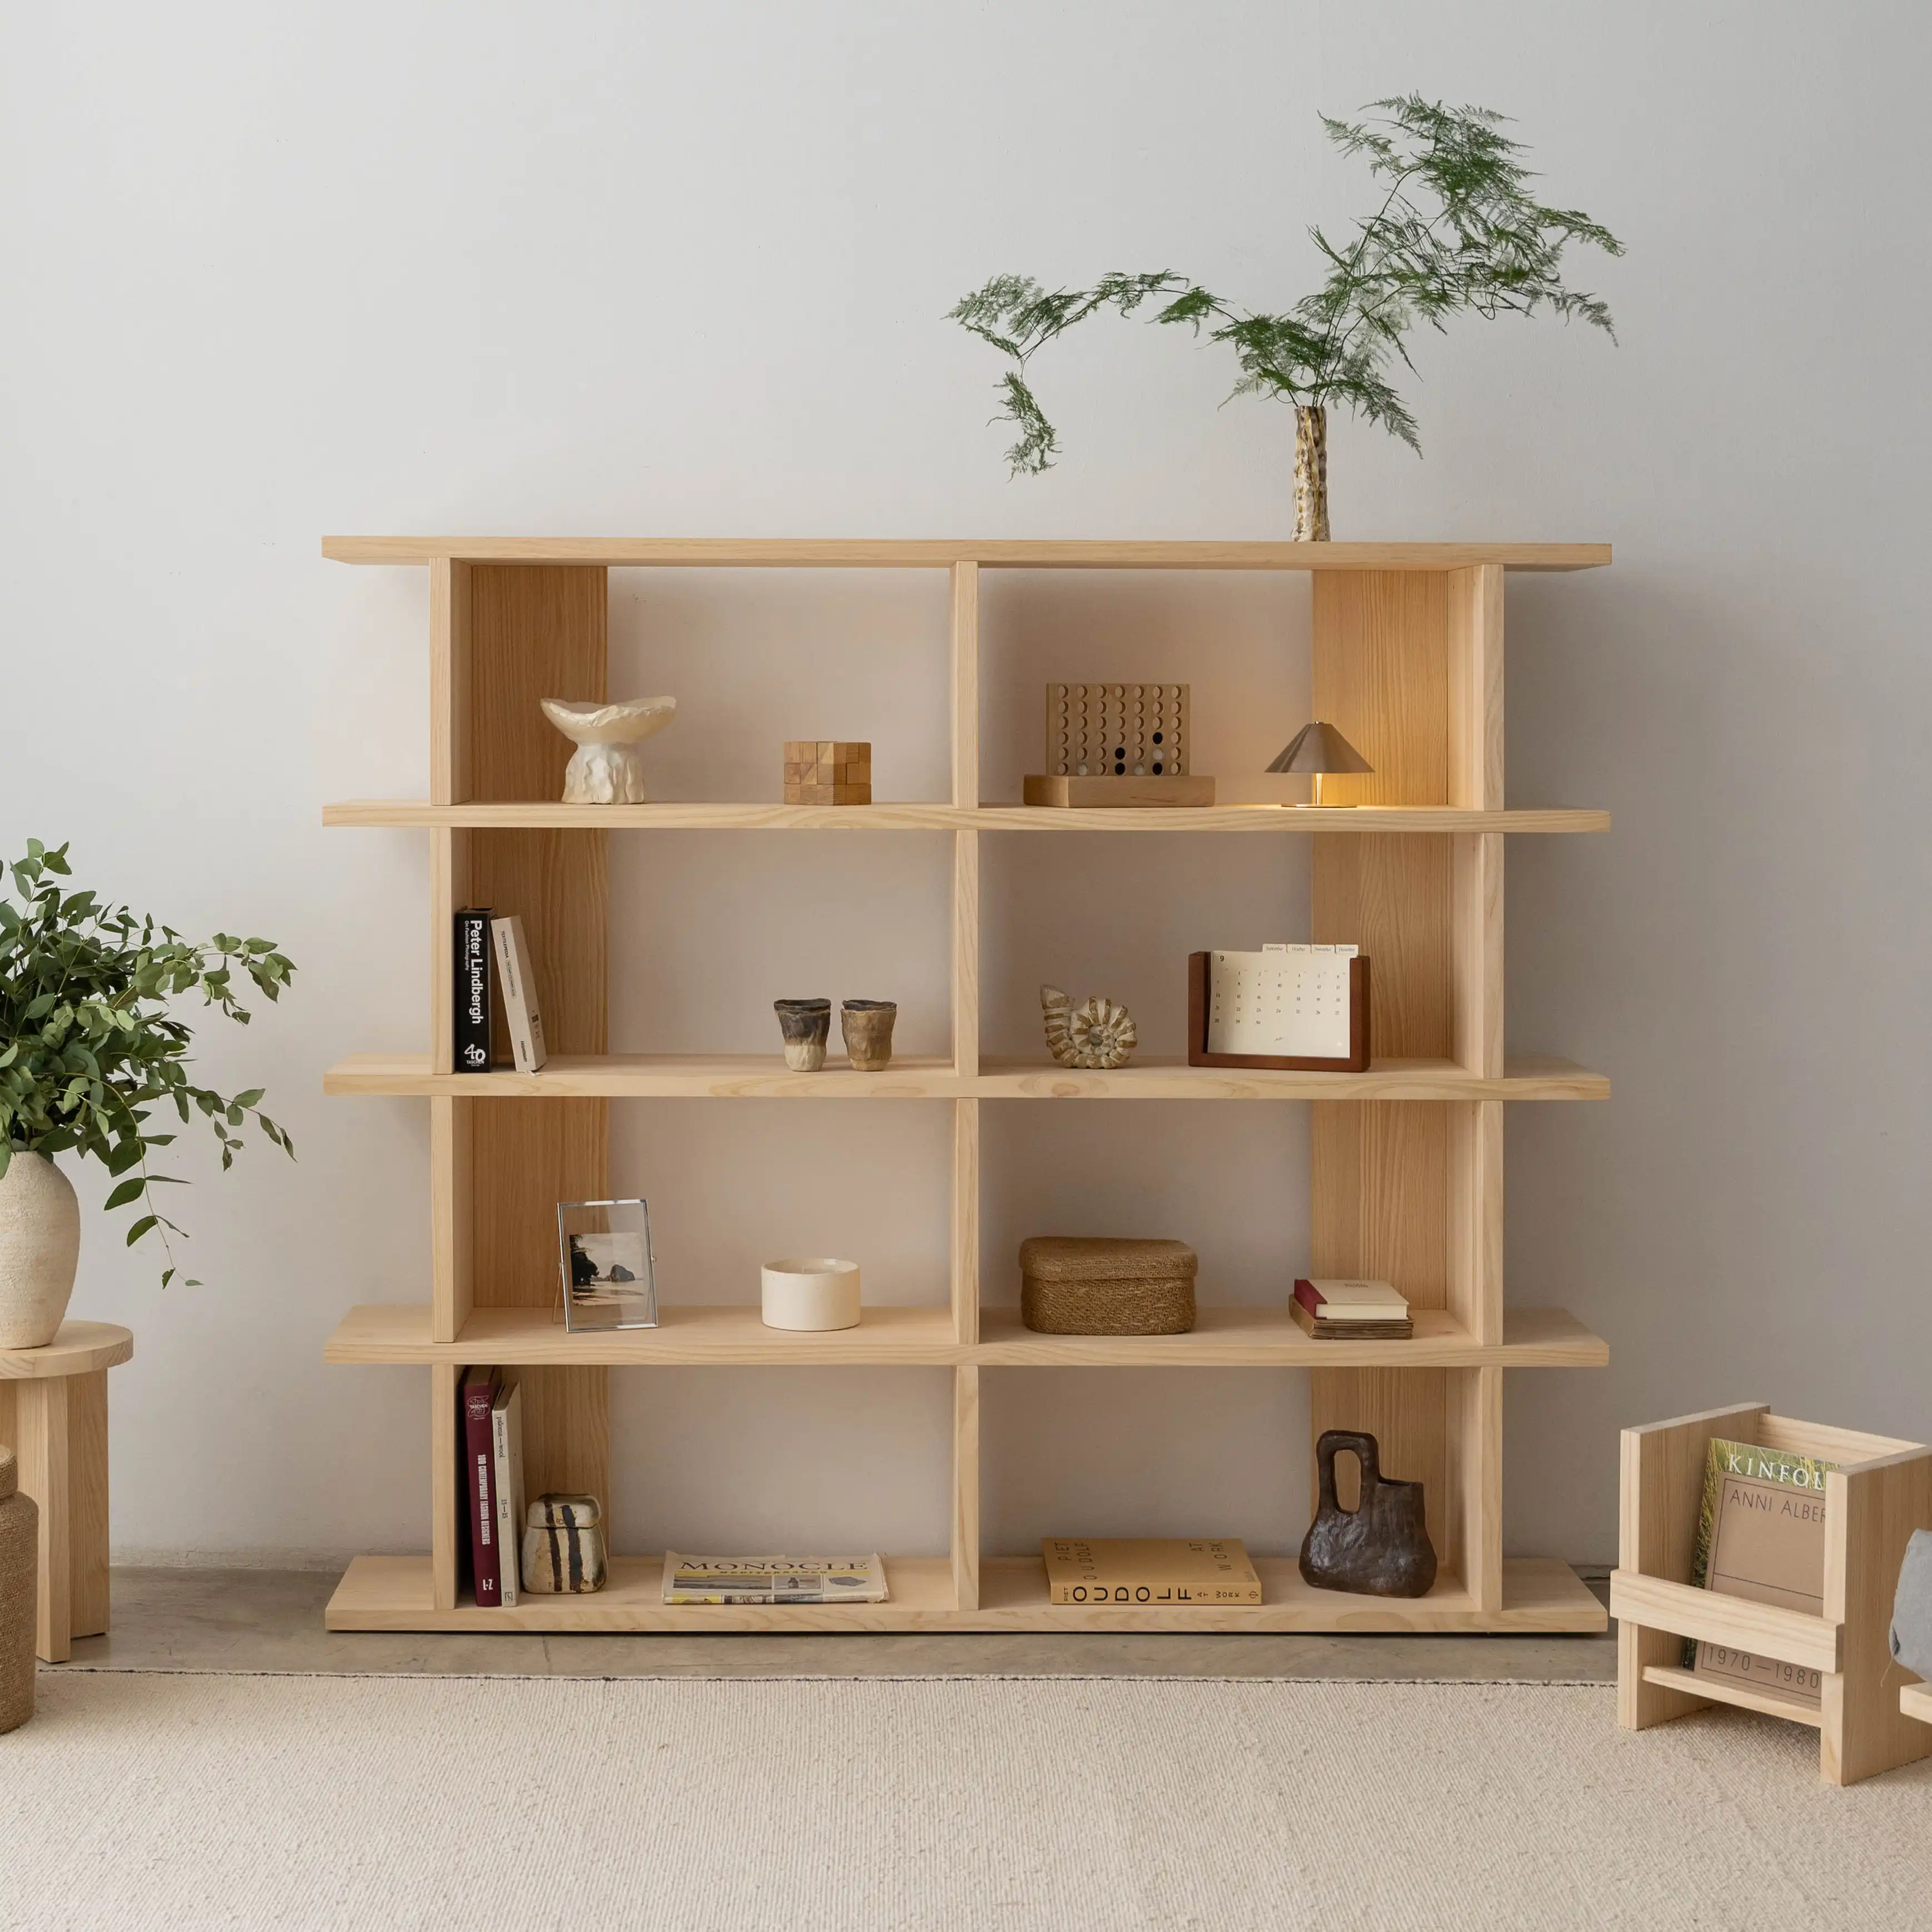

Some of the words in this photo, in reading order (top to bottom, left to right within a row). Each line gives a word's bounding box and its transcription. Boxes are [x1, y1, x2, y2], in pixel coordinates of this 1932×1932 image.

[470, 920, 482, 956] Peter
[468, 959, 484, 1024] Lindbergh
[477, 1454, 487, 1465] 100
[480, 1500, 489, 1520] FASHION
[1729, 1489, 1772, 1511] ANNI
[481, 1520, 491, 1545] DESIGNERS
[1054, 1542, 1072, 1561] PIET
[1188, 1542, 1205, 1552] AT
[1208, 1542, 1232, 1571] WORK
[680, 1562, 868, 1570] MONOCLE
[1074, 1542, 1097, 1579] OUDOLF
[1072, 1586, 1192, 1602] OUDOLF
[1216, 1591, 1240, 1599] WORK
